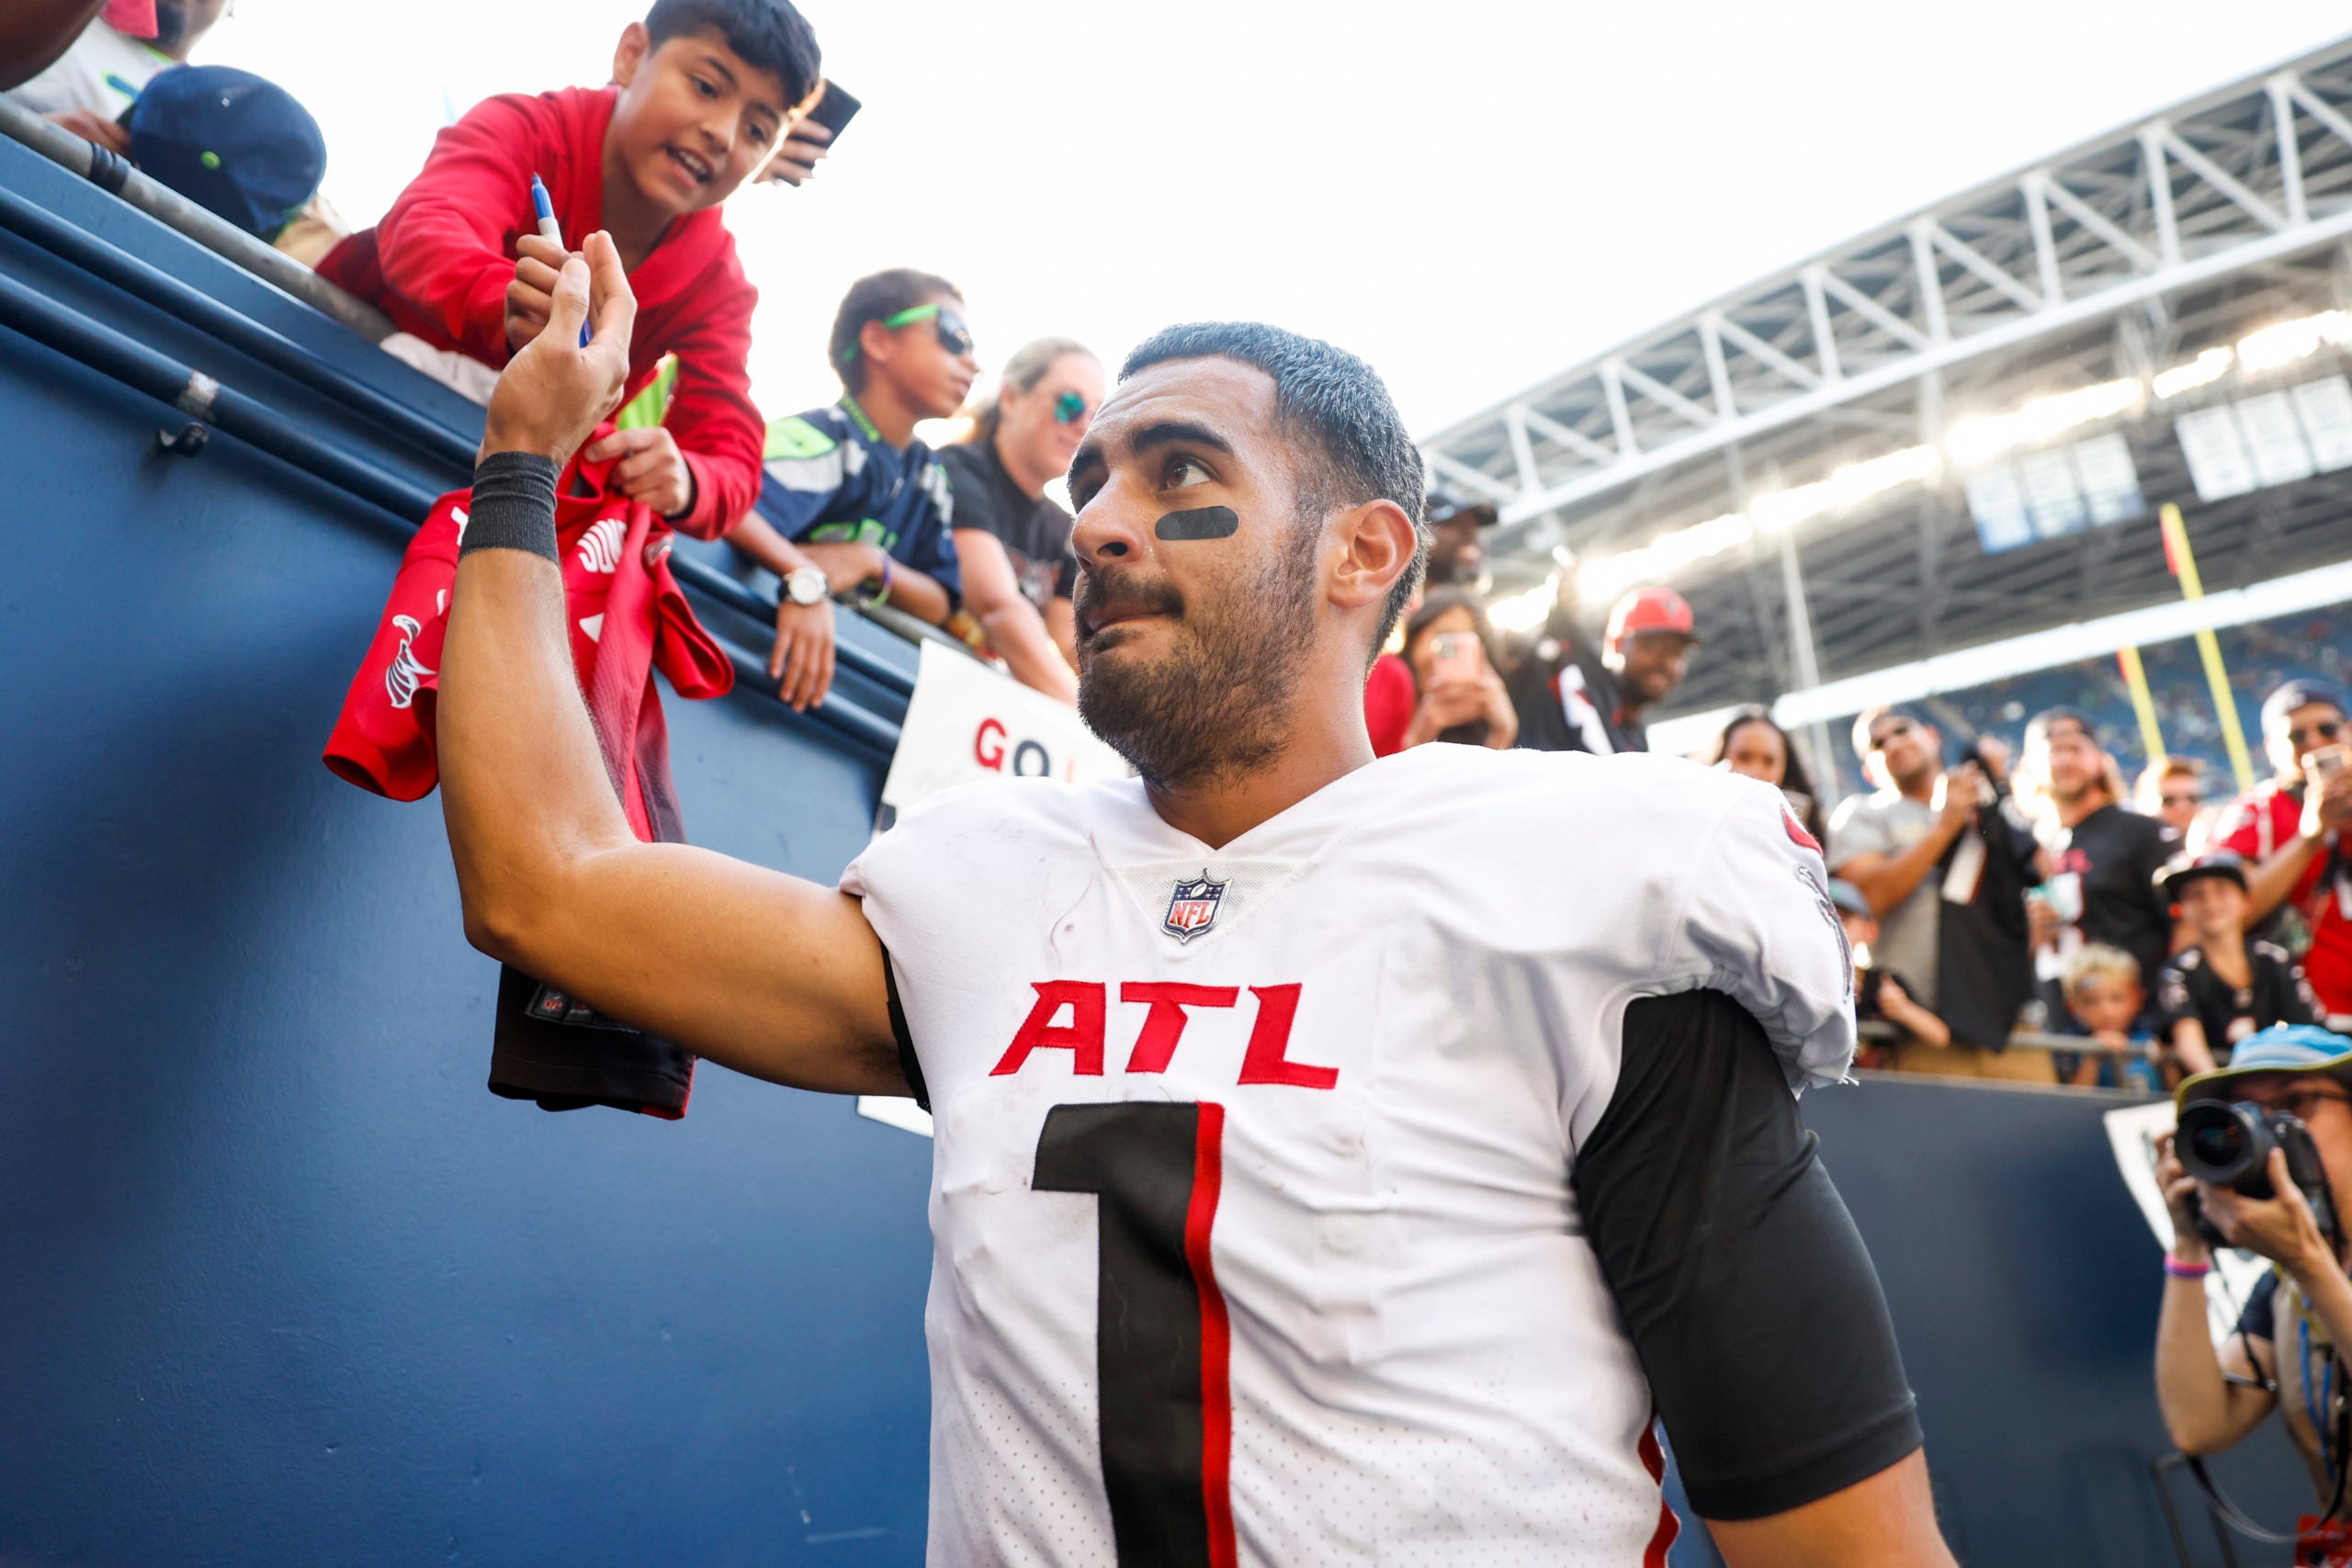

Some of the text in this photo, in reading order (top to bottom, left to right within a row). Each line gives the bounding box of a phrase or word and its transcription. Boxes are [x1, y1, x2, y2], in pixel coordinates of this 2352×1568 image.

[974, 717, 1051, 778] GO
[1170, 902, 1210, 928] NFL
[989, 980, 1339, 1089] ATL
[1031, 1100, 1238, 1568] 1
